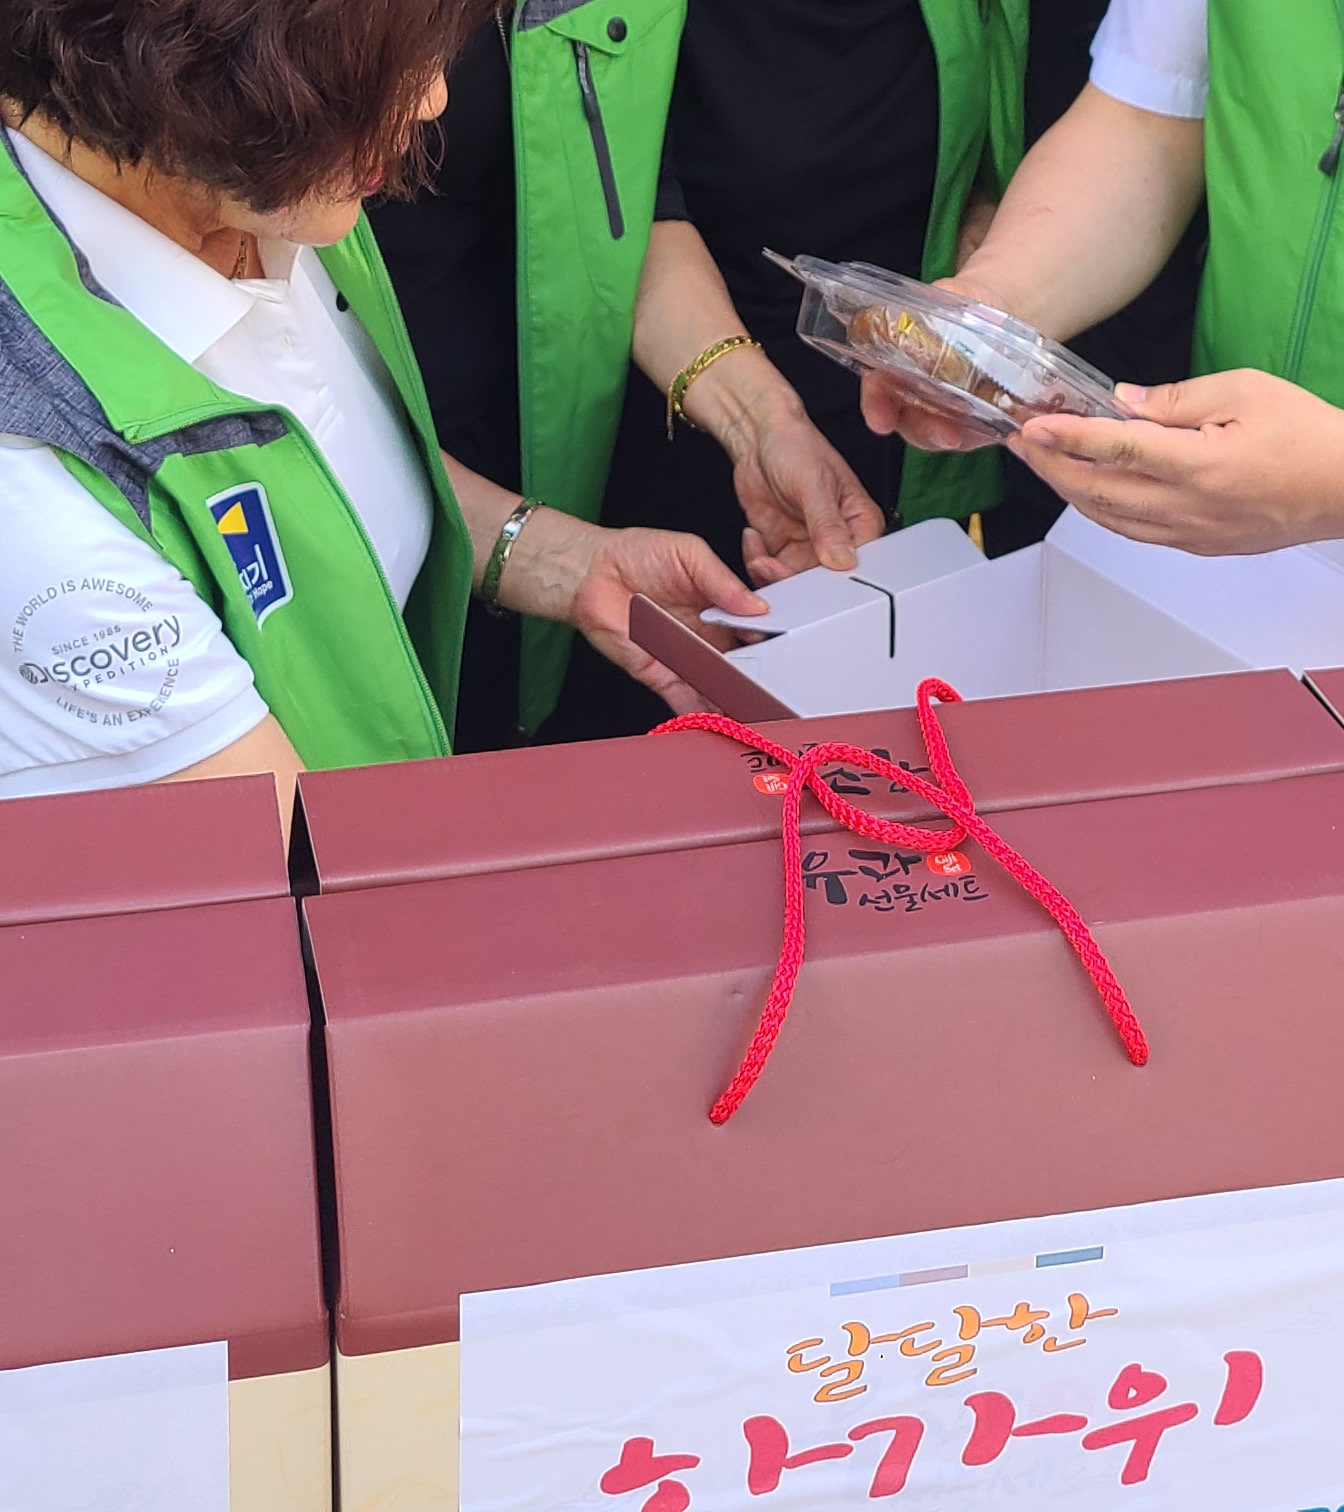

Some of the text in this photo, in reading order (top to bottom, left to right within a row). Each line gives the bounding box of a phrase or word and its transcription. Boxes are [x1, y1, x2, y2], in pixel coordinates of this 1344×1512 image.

[12, 577, 153, 653] THE WORLD IS AWESOME
[51, 636, 90, 656] SINCE
[102, 713, 123, 726] AN
[859, 875, 989, 912] 선물세트
[786, 1292, 1119, 1403] 달달한
